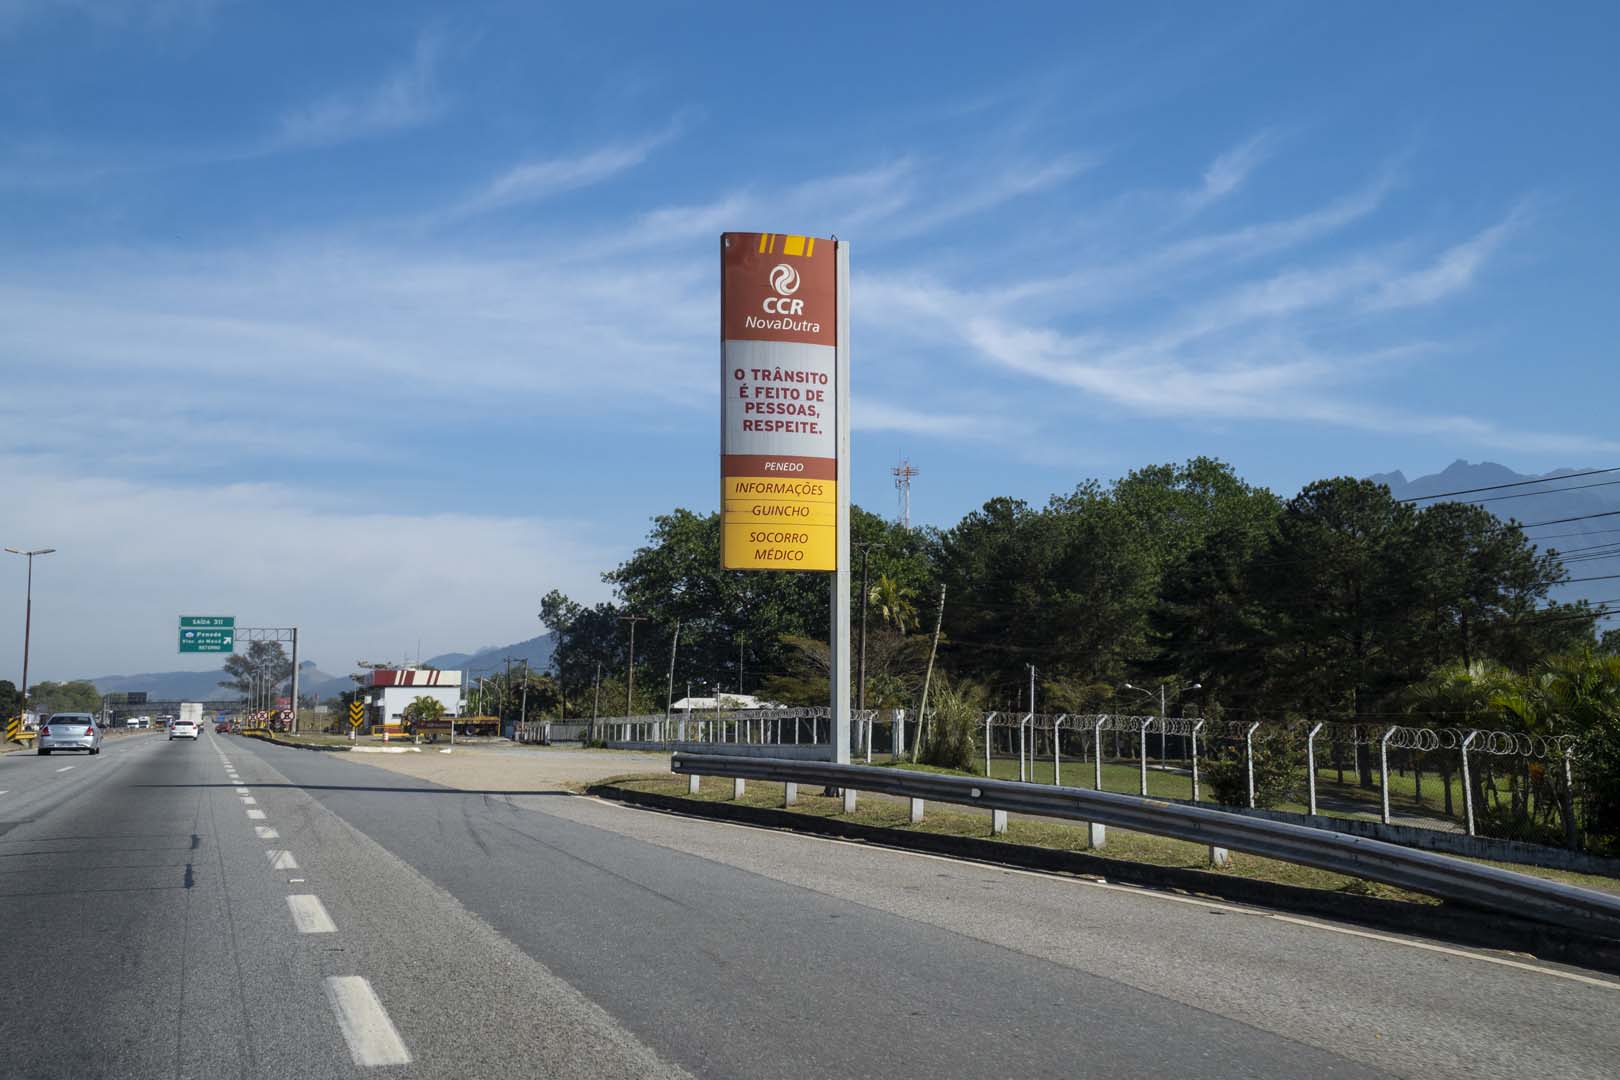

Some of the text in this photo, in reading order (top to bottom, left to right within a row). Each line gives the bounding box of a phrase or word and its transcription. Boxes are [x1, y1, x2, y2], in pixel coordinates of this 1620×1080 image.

[763, 297, 804, 316] CCR
[745, 316, 820, 333] NovaDutra
[734, 366, 829, 385] O TRÂNSITO
[739, 383, 825, 402] É FEITO DE
[745, 402, 820, 419] PESSOAS,
[743, 419, 823, 435] RESPEITE.
[764, 462, 805, 472] PENEDO
[735, 481, 824, 497] INFORMAÇÕES
[752, 505, 810, 517] GUINCHO
[749, 532, 809, 544] SOCORRO
[754, 548, 804, 561] MÉDICO
